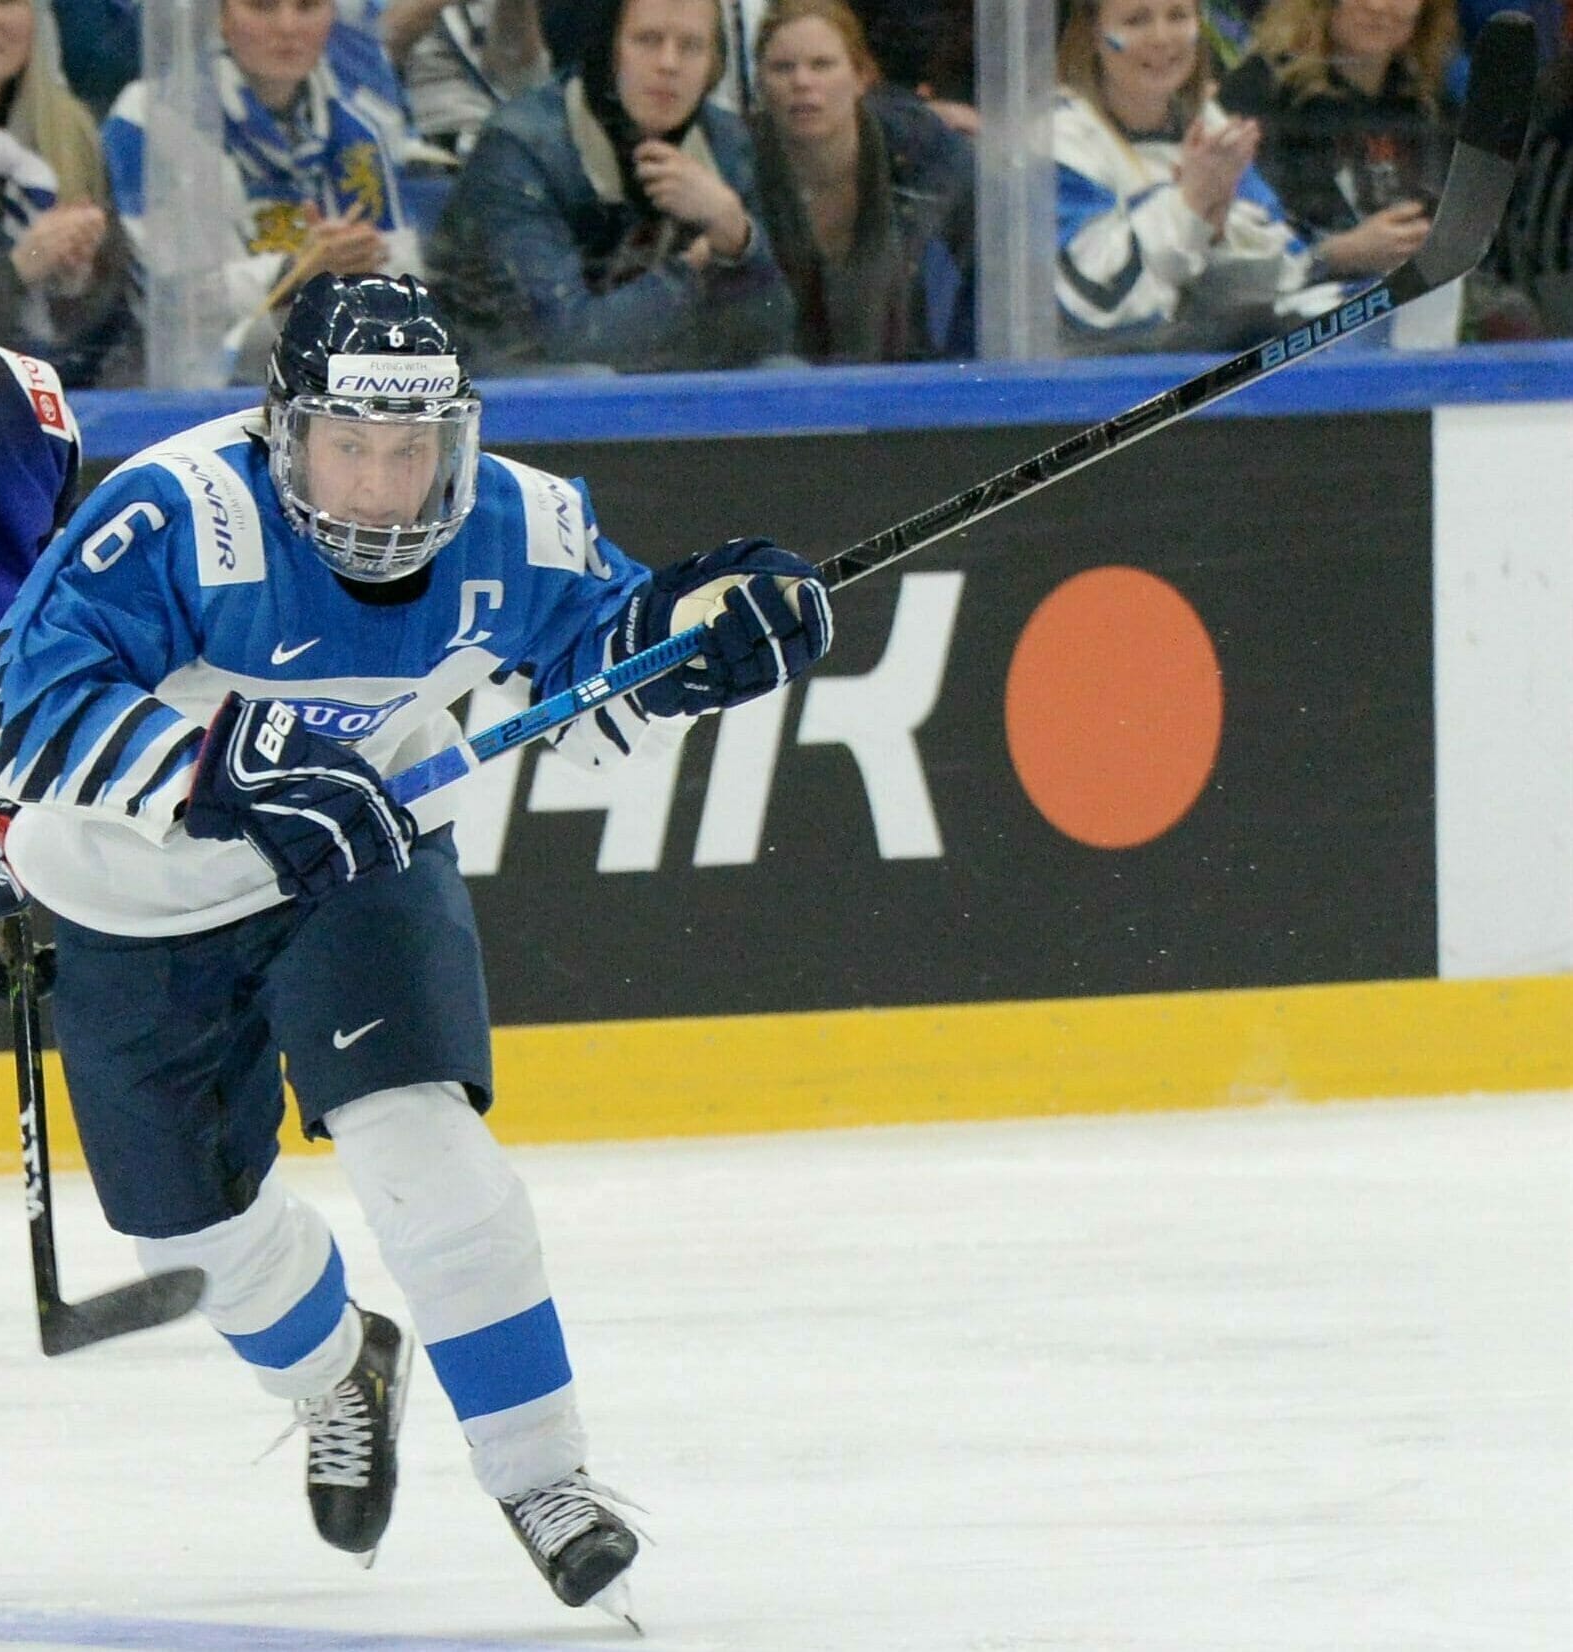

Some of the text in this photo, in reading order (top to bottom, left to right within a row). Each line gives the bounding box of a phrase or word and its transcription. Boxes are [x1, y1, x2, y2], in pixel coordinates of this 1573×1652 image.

[389, 325, 405, 348] 6
[405, 362, 427, 371] WITH
[336, 375, 455, 393] FINNAIR
[82, 502, 165, 573] 6
[445, 580, 503, 649] C
